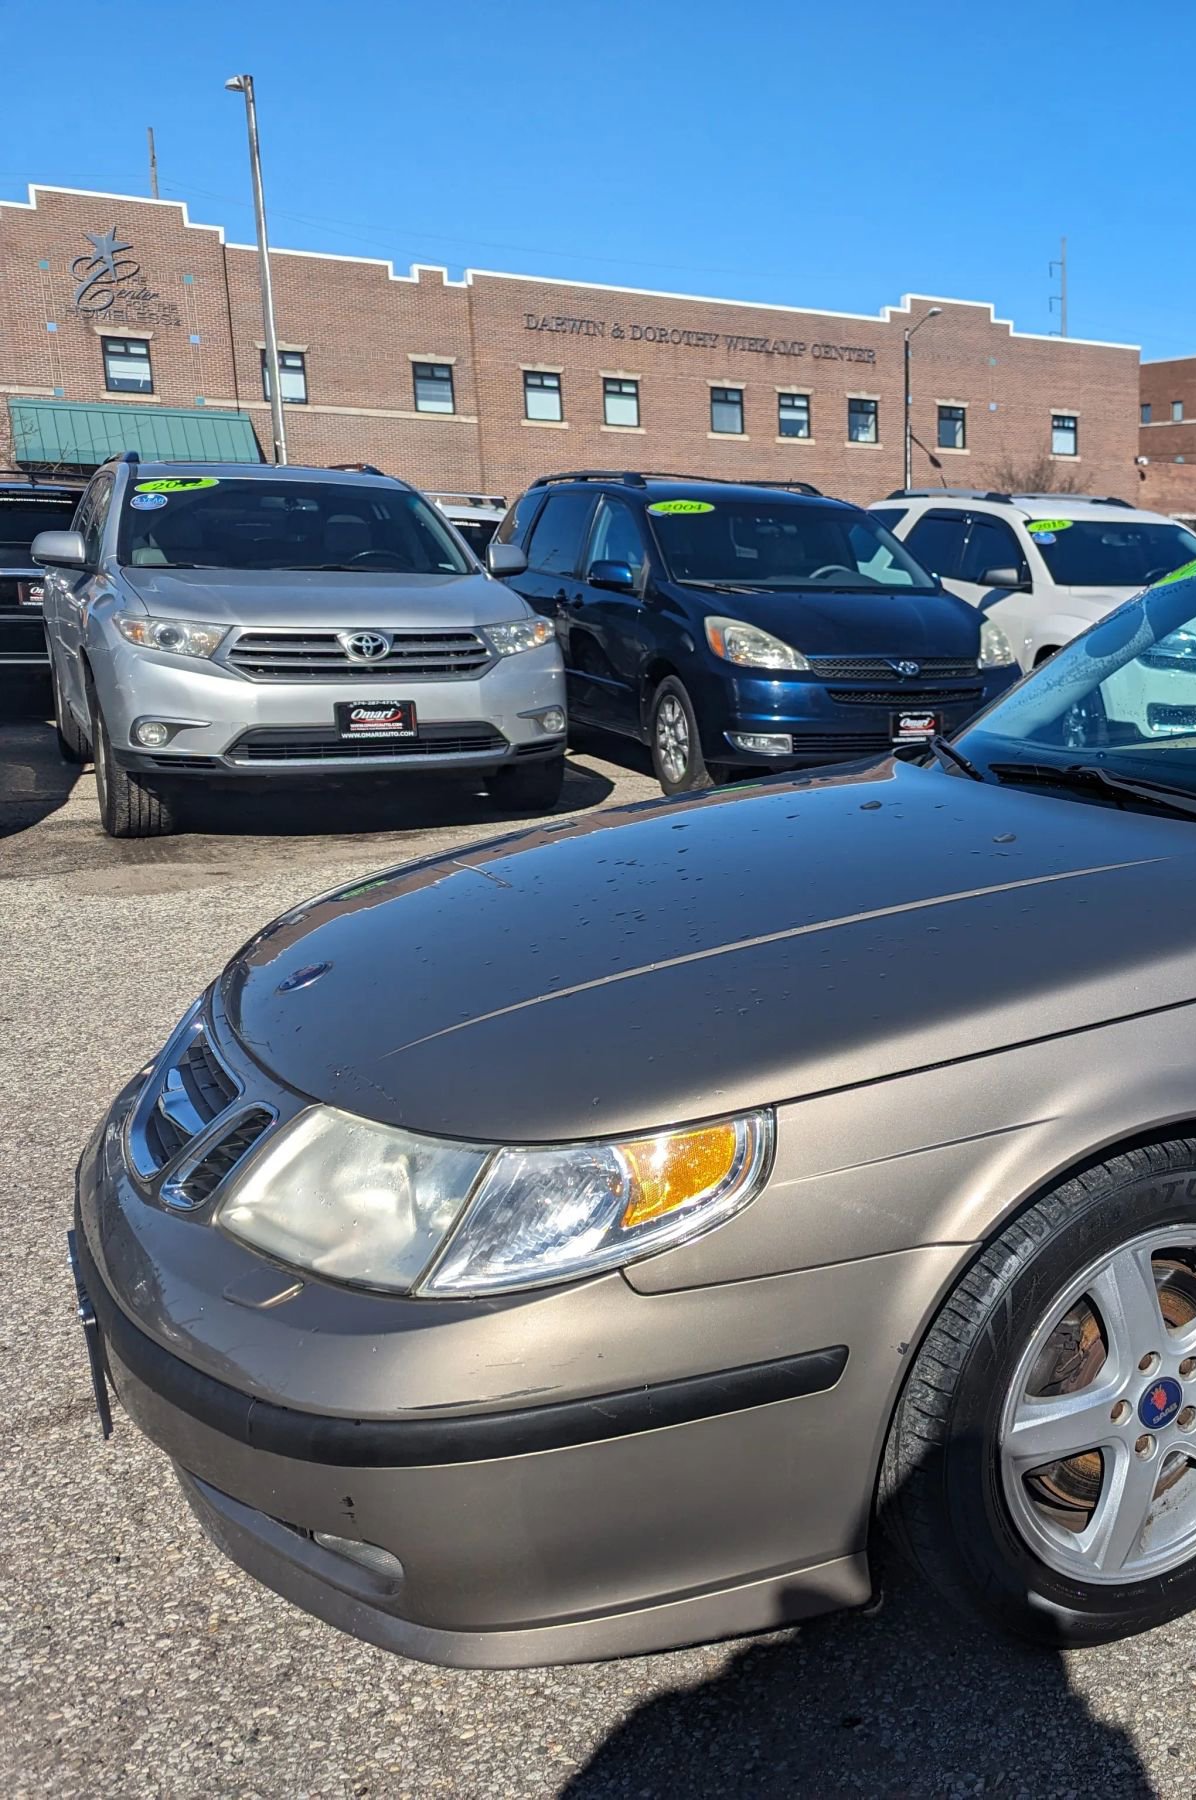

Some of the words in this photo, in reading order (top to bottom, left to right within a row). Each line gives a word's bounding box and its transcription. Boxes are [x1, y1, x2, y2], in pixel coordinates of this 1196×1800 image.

[523, 313, 605, 338] DARWIN
[611, 322, 625, 340] &
[630, 324, 720, 350] DOROTHY
[811, 343, 876, 364] CENTER
[662, 503, 702, 511] 2004
[351, 708, 396, 721] Omari
[1152, 1402, 1178, 1424] SAAB
